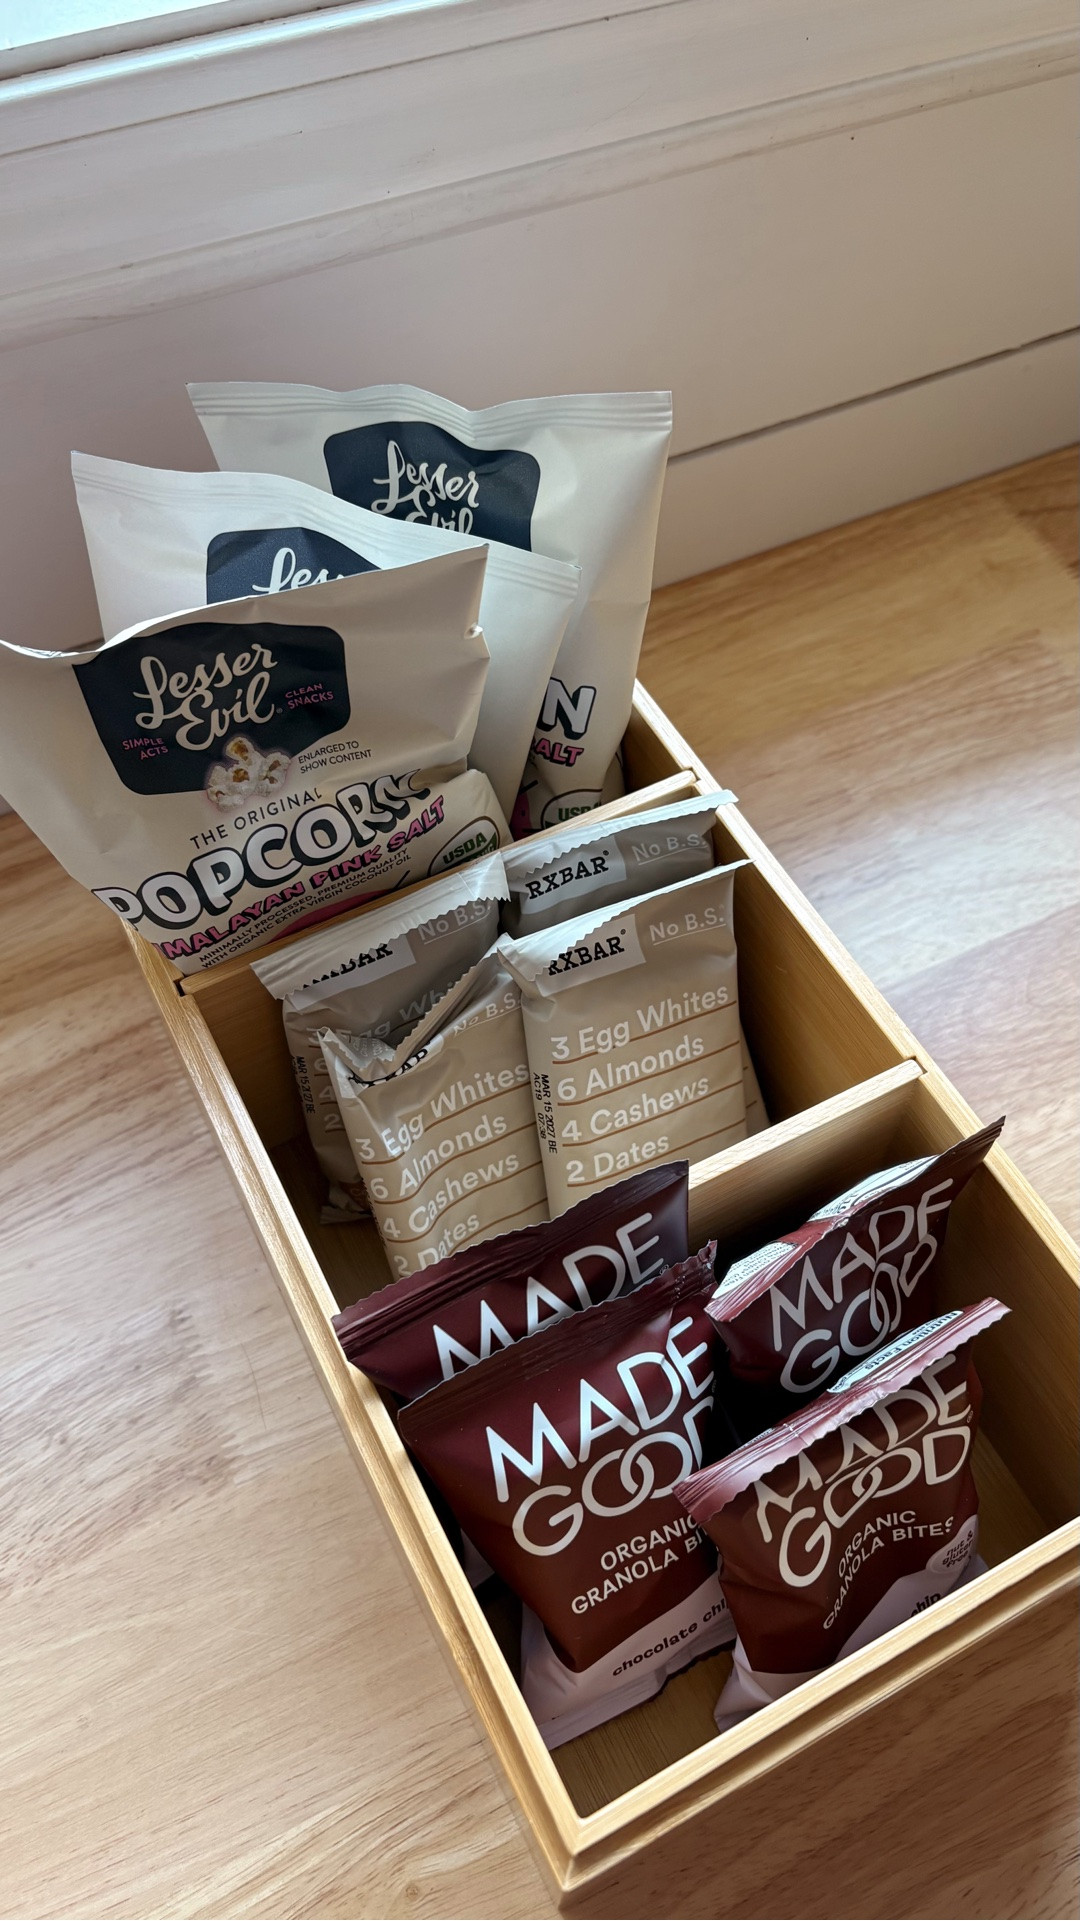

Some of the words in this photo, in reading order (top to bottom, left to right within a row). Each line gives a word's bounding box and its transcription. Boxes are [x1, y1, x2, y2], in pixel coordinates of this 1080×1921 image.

[371, 440, 479, 514] Lesser
[133, 643, 278, 729] Lesser
[285, 683, 323, 699] CLEAN
[287, 691, 334, 709] SNACKS
[122, 737, 164, 750] SIMPLE
[140, 745, 169, 760] ACTS
[298, 743, 345, 764] ENLARGED
[346, 740, 360, 750] TO
[300, 758, 328, 774] SHOW
[329, 749, 373, 766] CONTENT
[532, 736, 585, 767] ALT
[190, 824, 228, 849] THE
[234, 787, 322, 830] ORIGINAL
[310, 845, 383, 889] PINK
[388, 795, 444, 852] SALT
[443, 832, 487, 864] USDA
[632, 843, 660, 861] No
[667, 834, 707, 849] B.S.
[525, 856, 609, 899] RXBAR
[199, 925, 253, 962] MINIMALLY
[255, 895, 317, 930] PROCESSED,
[318, 872, 366, 896] PREMIUM
[368, 849, 408, 873] QUALITY
[201, 954, 228, 969] WITH
[228, 924, 275, 953] ORGANIC
[276, 906, 305, 926] EXTRA
[307, 888, 343, 907] VIRGIN
[345, 864, 394, 890] COCONUT
[395, 854, 411, 867] OIL
[417, 919, 448, 941] No
[454, 901, 491, 927] B.S.
[649, 922, 678, 942] No
[684, 907, 724, 930] B.S.
[548, 936, 625, 976] RXBAR
[453, 1016, 479, 1036] No
[551, 1036, 570, 1060] 3
[579, 1020, 630, 1055] Egg
[636, 986, 728, 1032] Whites
[319, 1085, 335, 1099] 4
[541, 1074, 551, 1098] MAR
[557, 1078, 577, 1101] 6
[585, 1035, 704, 1096] Almonds
[324, 1113, 342, 1131] 2
[355, 1139, 375, 1159] 3
[380, 1112, 424, 1157] Egg
[431, 1063, 530, 1119] Whites
[544, 1101, 553, 1112] 15
[545, 1114, 556, 1138] 2027
[561, 1119, 582, 1141] 4
[590, 1077, 709, 1135] Cashews
[370, 1178, 388, 1199] 6
[399, 1115, 507, 1196] Almonds
[548, 1140, 558, 1154] BE
[566, 1160, 585, 1182] 2
[594, 1135, 670, 1178] Dates
[383, 1218, 400, 1238] 4
[408, 1153, 520, 1233] Cashews
[394, 1255, 411, 1277] 2
[418, 1214, 479, 1270] Dates
[432, 1212, 664, 1381] MADE
[780, 1234, 938, 1393] GOOD
[902, 1312, 959, 1347] Nutrition
[864, 1346, 903, 1371] Facts
[486, 1316, 714, 1503] MADE
[754, 1353, 973, 1543] MADE
[779, 1426, 971, 1587] GOOD
[600, 1513, 698, 1571] ORGANIC
[838, 1510, 916, 1579] ORGANIC
[571, 1549, 679, 1615] GRANOLA
[823, 1536, 884, 1629] GRANOLA
[892, 1516, 954, 1541] BITES
[612, 1622, 699, 1677] chocolate
[702, 1598, 729, 1623] chi
